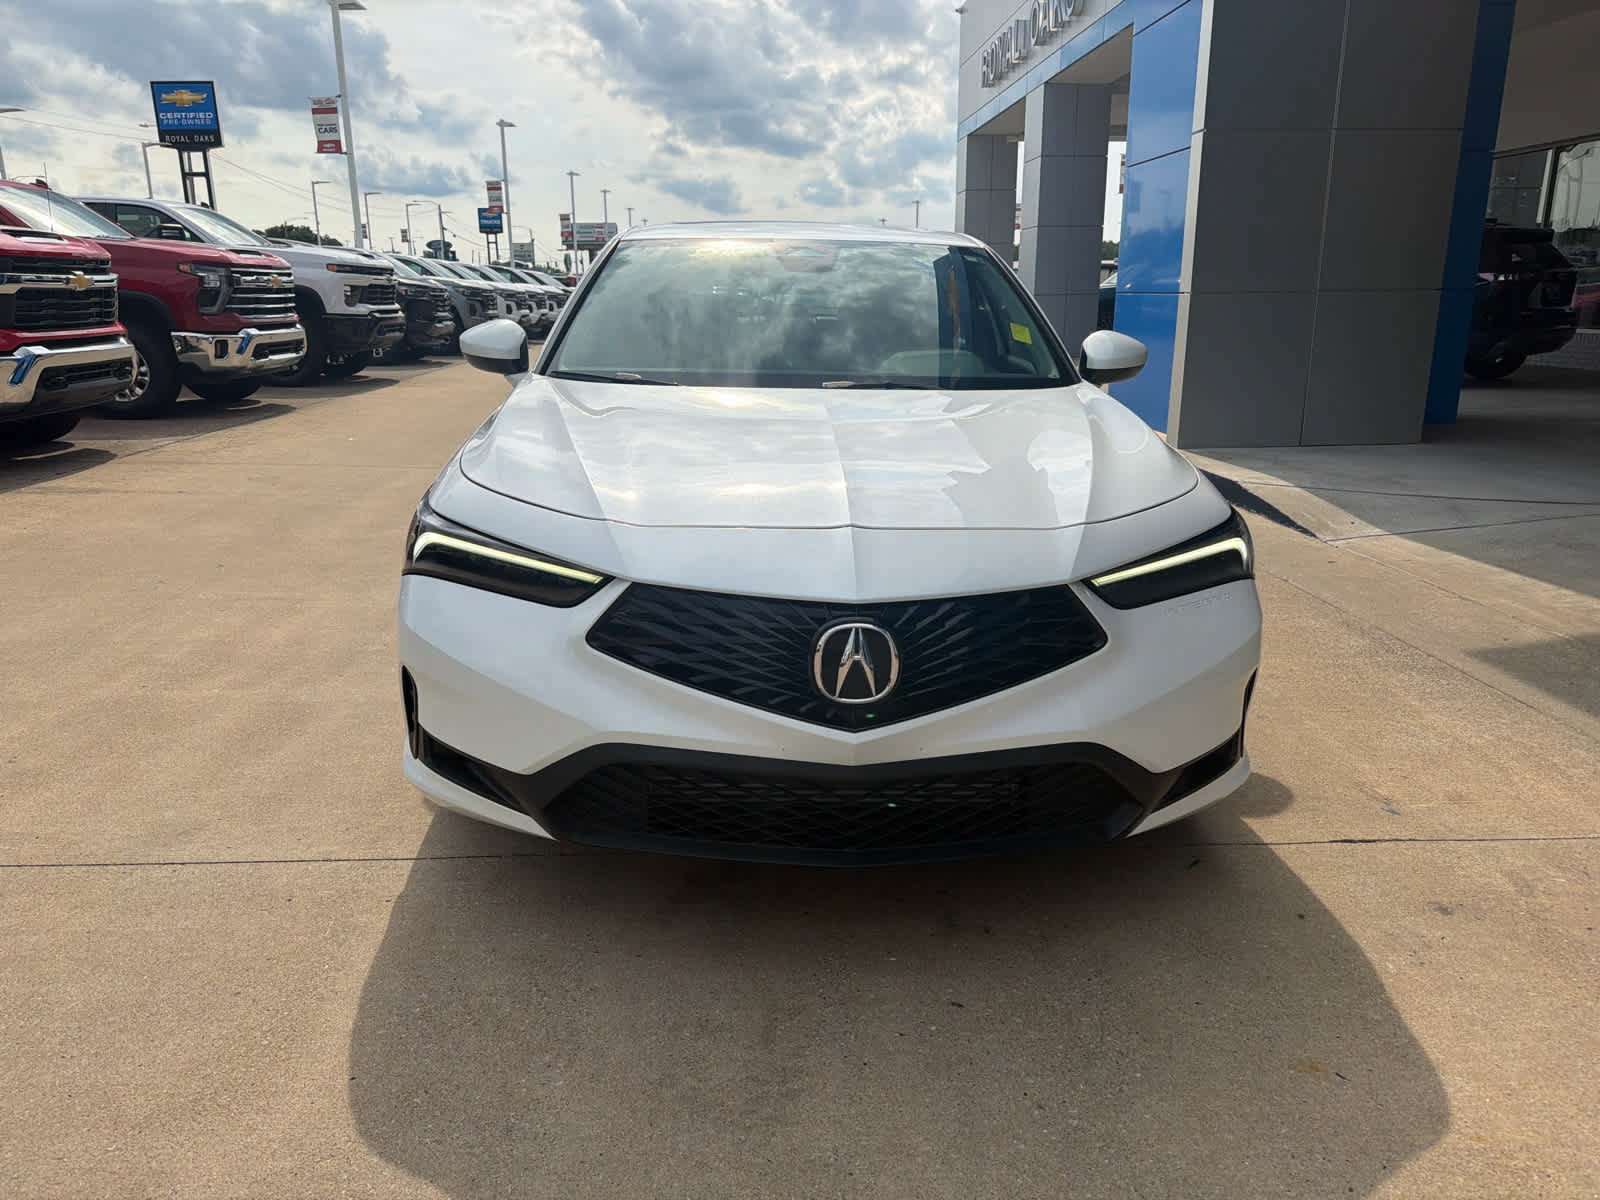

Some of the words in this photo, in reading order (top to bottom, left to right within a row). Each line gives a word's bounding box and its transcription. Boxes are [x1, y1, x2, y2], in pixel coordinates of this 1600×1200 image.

[981, 20, 1026, 88] ROYAL
[318, 126, 338, 134] CARS
[165, 135, 190, 143] ROYAL
[194, 135, 215, 143] OAKS
